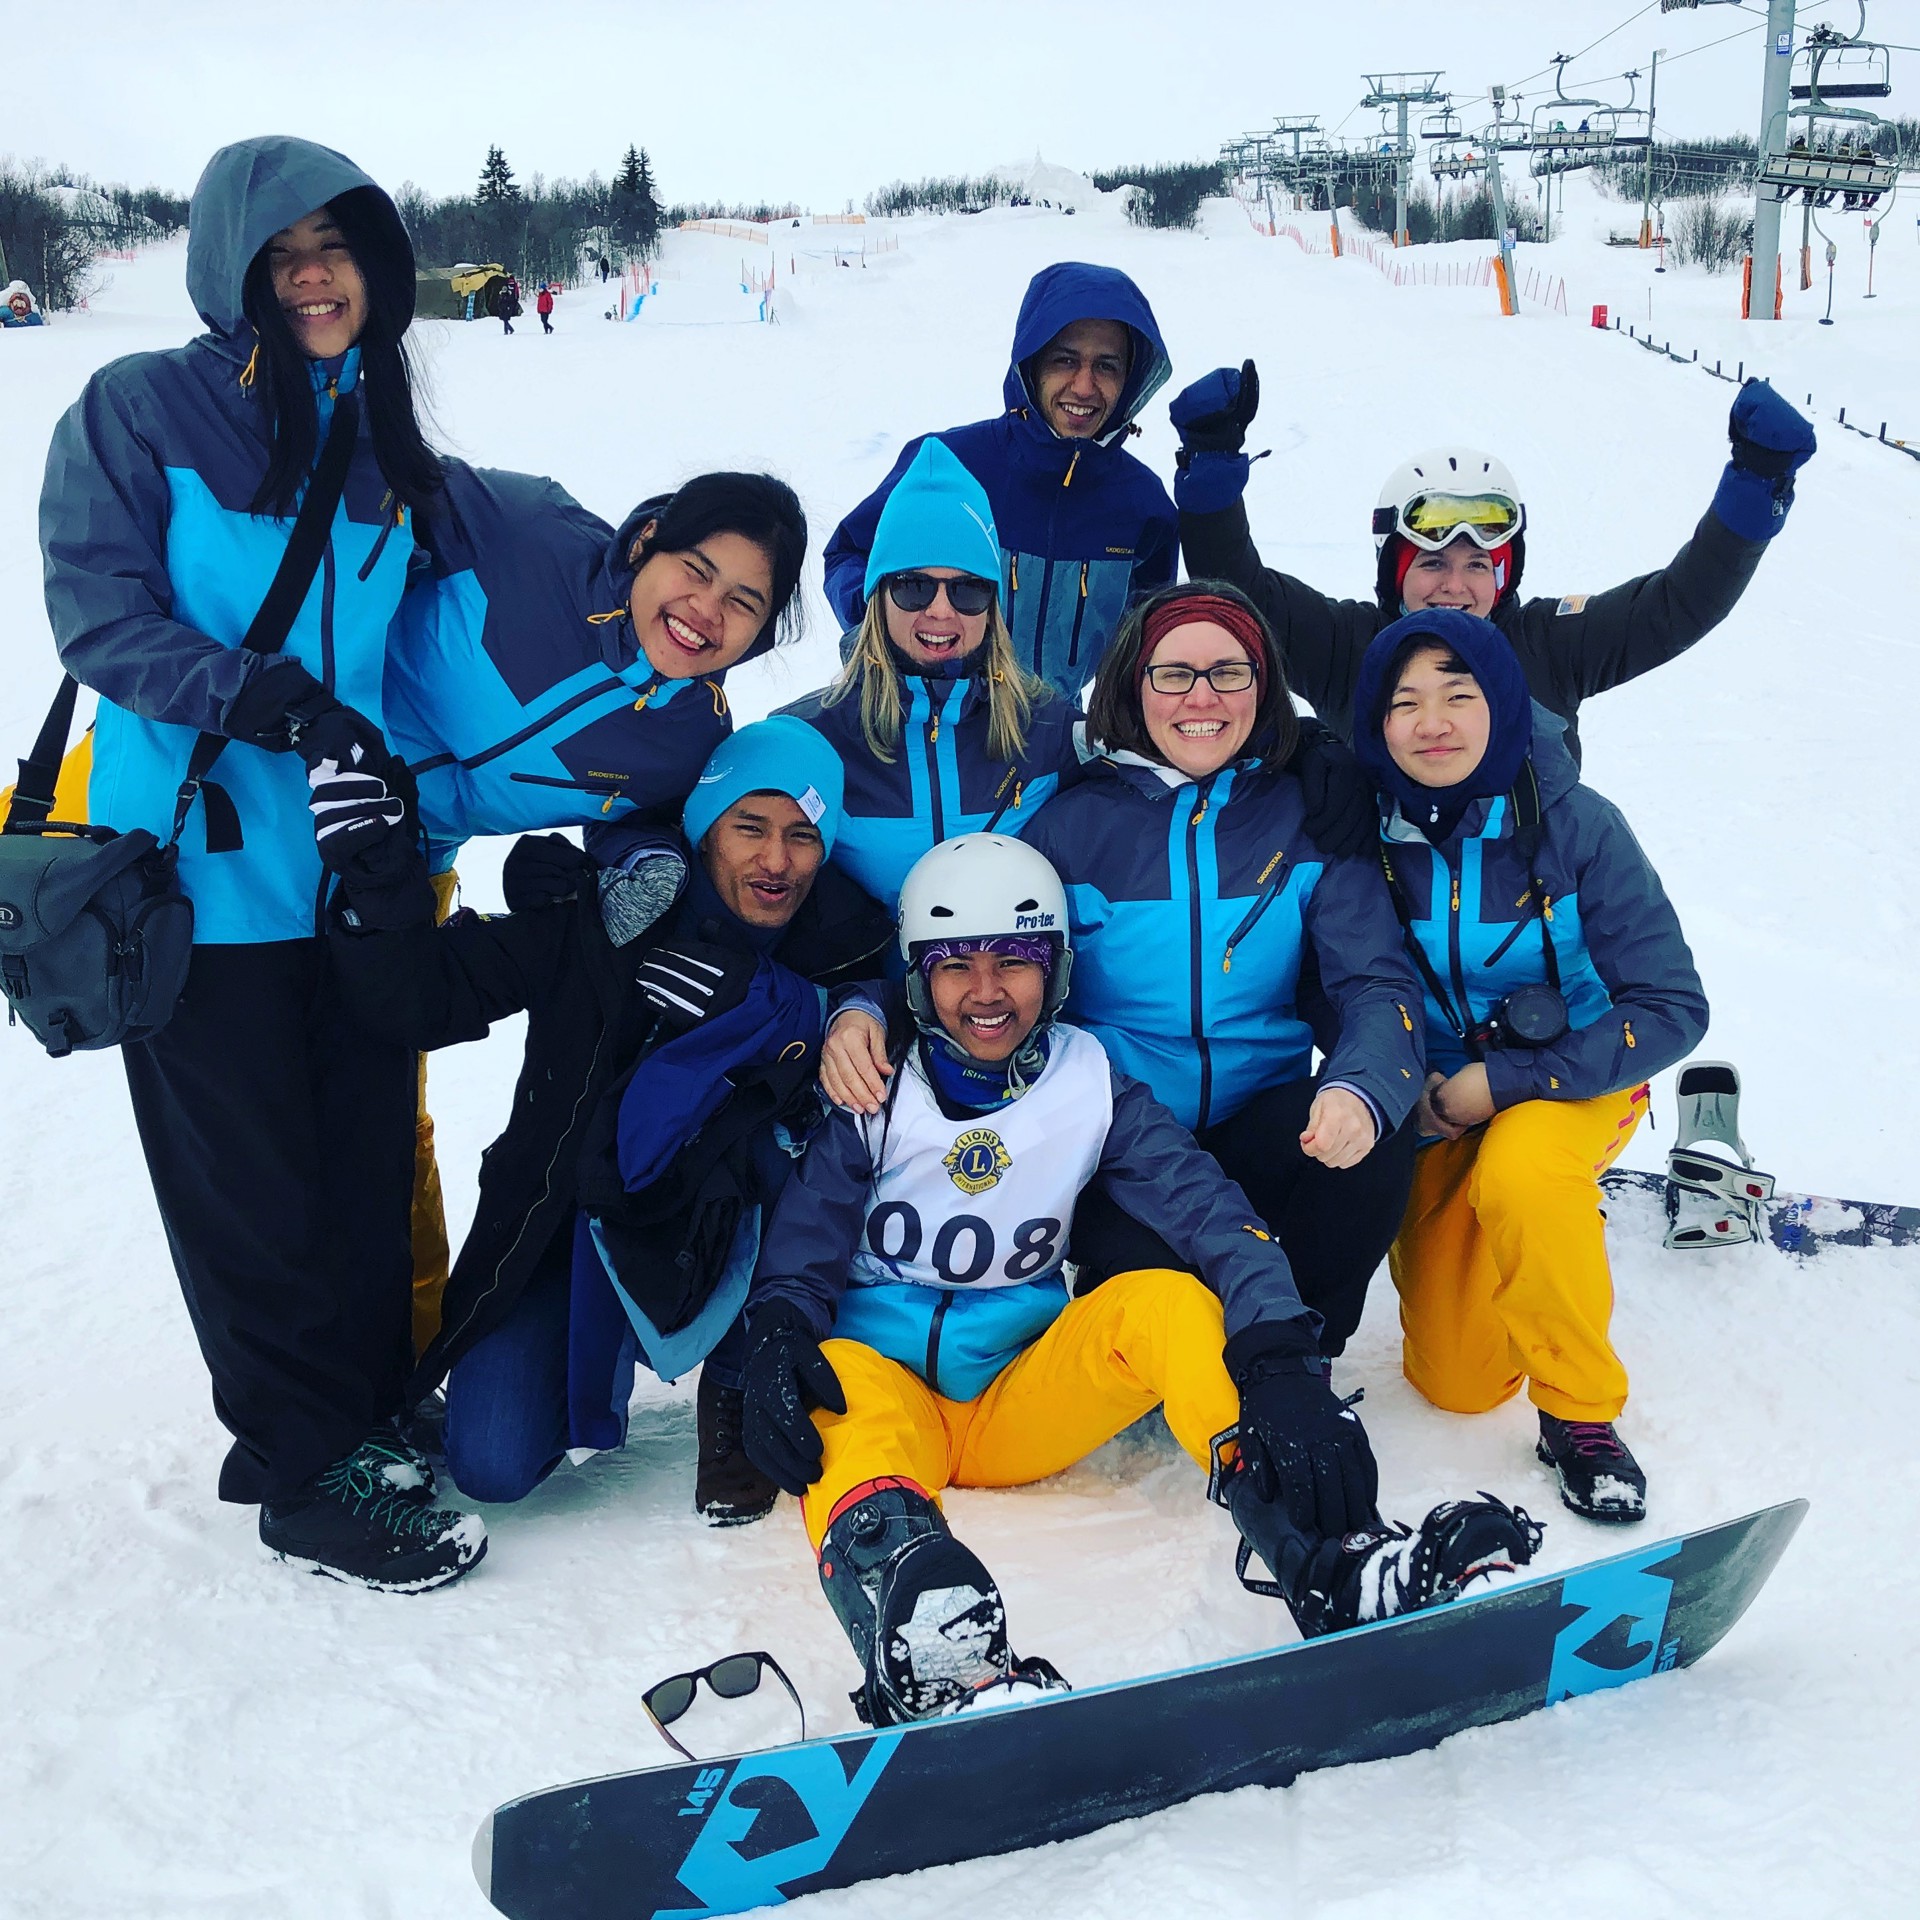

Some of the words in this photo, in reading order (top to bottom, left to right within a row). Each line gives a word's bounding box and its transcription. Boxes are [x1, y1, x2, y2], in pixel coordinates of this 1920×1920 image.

[587, 770, 630, 780] SKOGSTAD
[994, 766, 1017, 799] SKOGSTAD
[1256, 850, 1284, 885] SKOGSTAD
[959, 1131, 998, 1147] LIONS
[970, 1149, 986, 1173] L
[954, 1175, 995, 1191] INTERNATIONAL
[866, 1200, 1062, 1284] 008
[677, 1767, 726, 1817] 145
